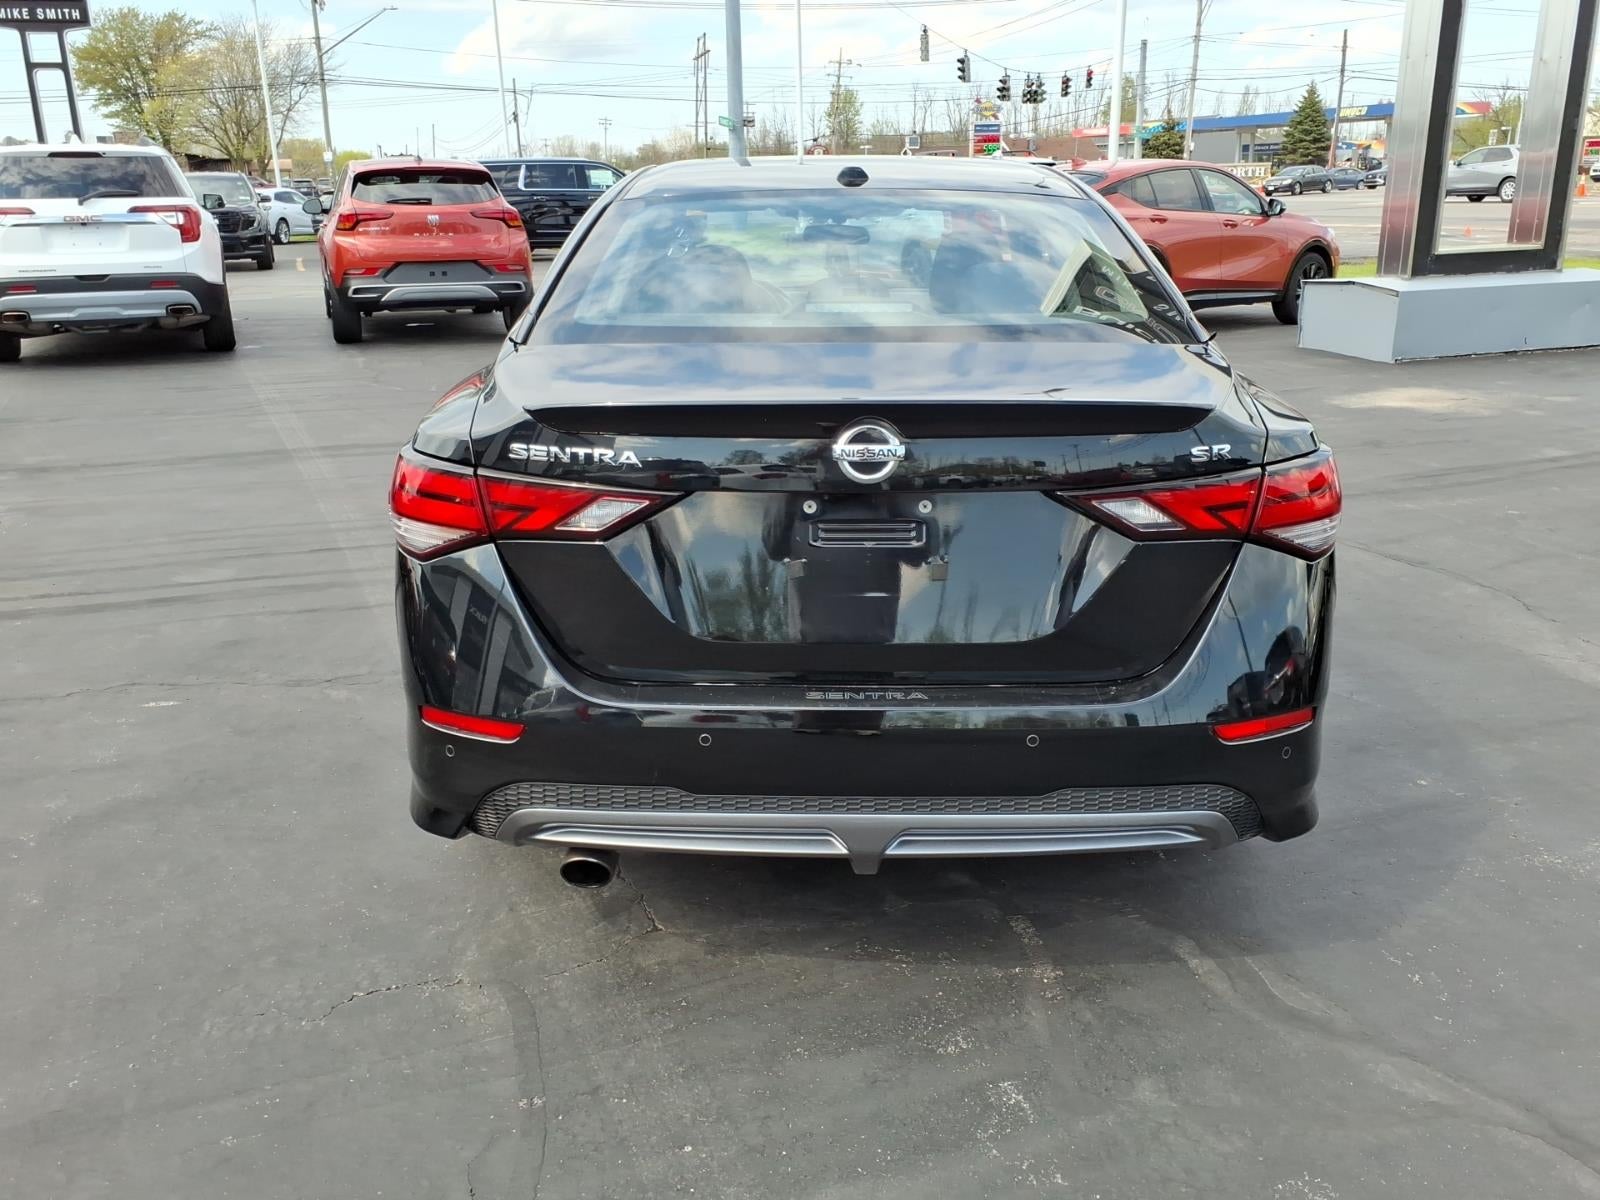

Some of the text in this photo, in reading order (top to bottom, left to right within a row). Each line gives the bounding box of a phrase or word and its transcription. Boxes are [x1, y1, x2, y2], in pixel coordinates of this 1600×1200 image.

[36, 8, 80, 20] SMITH
[63, 215, 104, 223] GMC
[508, 443, 643, 468] SENTRA
[840, 447, 898, 459] NISSAN
[1190, 443, 1233, 464] SR
[804, 690, 930, 701] SENTRA
